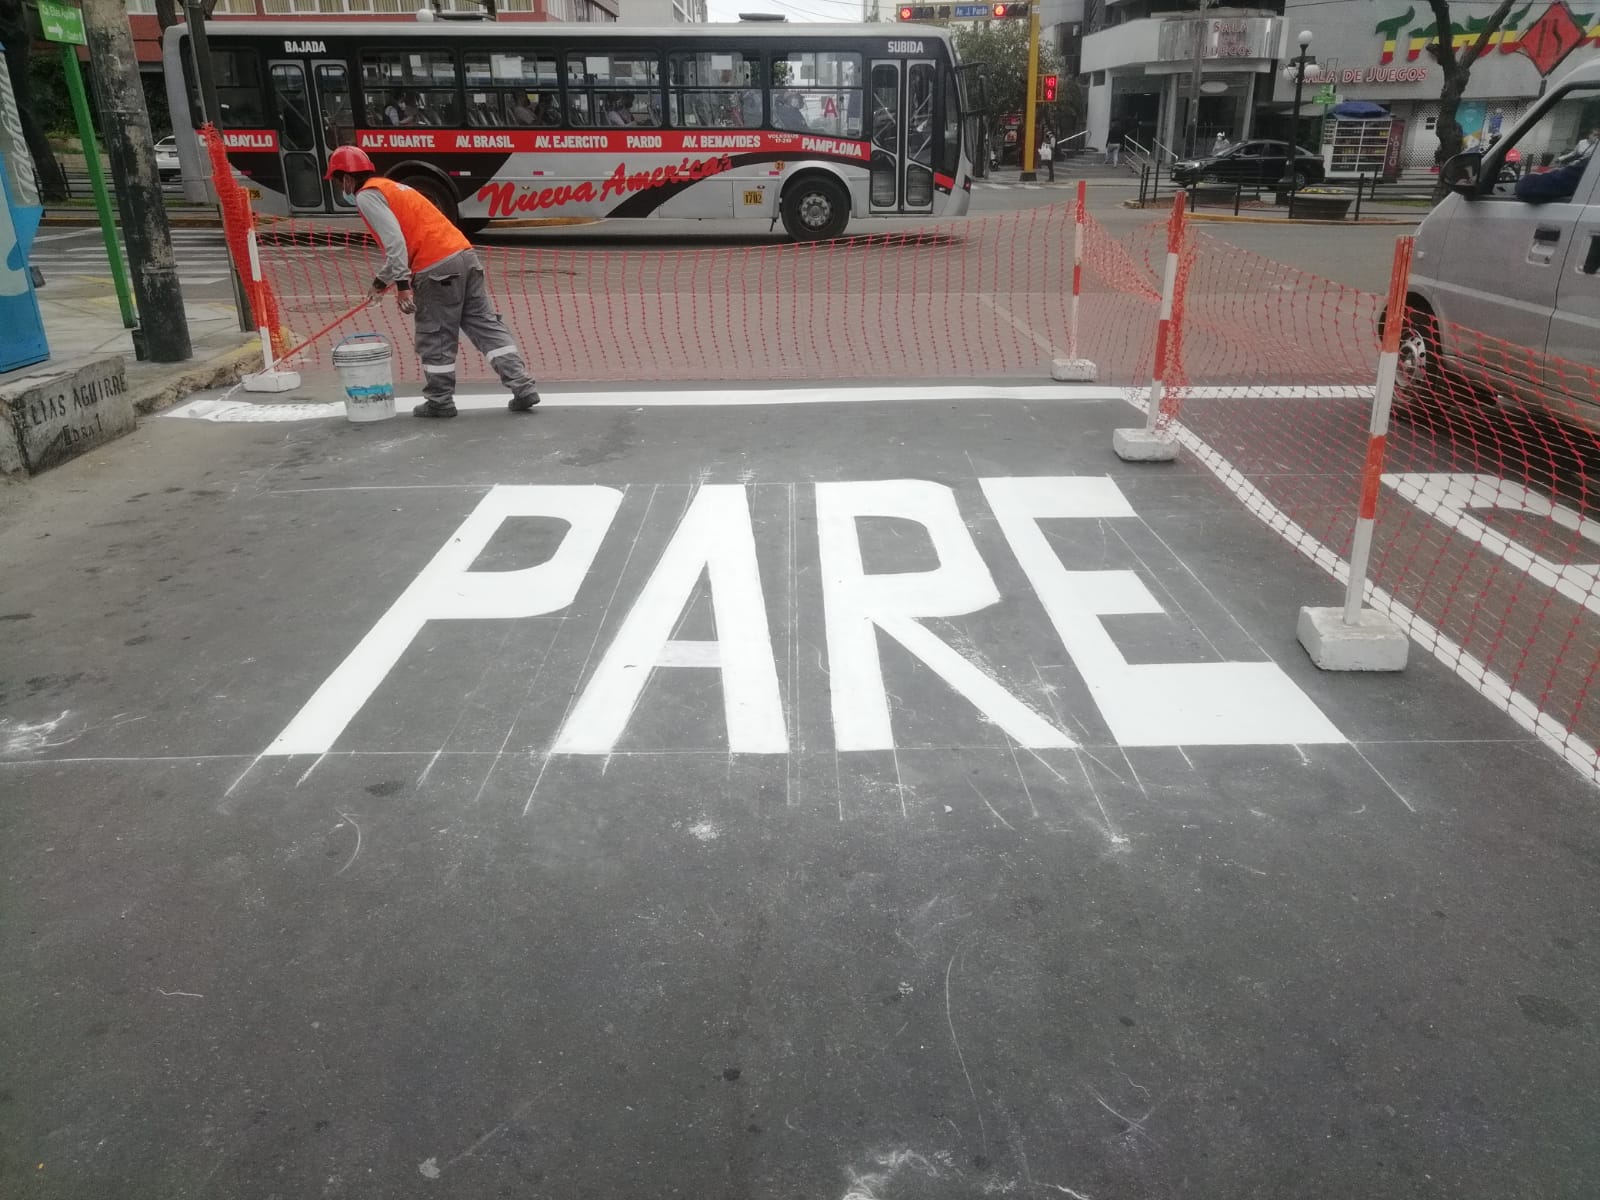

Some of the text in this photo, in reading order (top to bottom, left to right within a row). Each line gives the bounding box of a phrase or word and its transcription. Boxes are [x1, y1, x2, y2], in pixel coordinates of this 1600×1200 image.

[1212, 21, 1249, 33] SALA
[284, 40, 327, 54] BAJADA
[887, 41, 924, 54] SUBIDA
[1200, 46, 1257, 57] JUEGOS
[1342, 69, 1364, 82] DE
[1366, 66, 1428, 82] JUEGOS
[362, 135, 436, 148] ALF. UGARTE
[455, 135, 515, 148] AV. BRASIL
[536, 136, 608, 149] AV. EJERCITO
[626, 136, 662, 149] PARDO
[682, 135, 761, 149] AV. BENAVIDES
[802, 138, 863, 157] PAMPLONA
[477, 181, 598, 217] Nueva
[73, 373, 128, 410] AGUIRRE
[263, 475, 1349, 757] PARE
